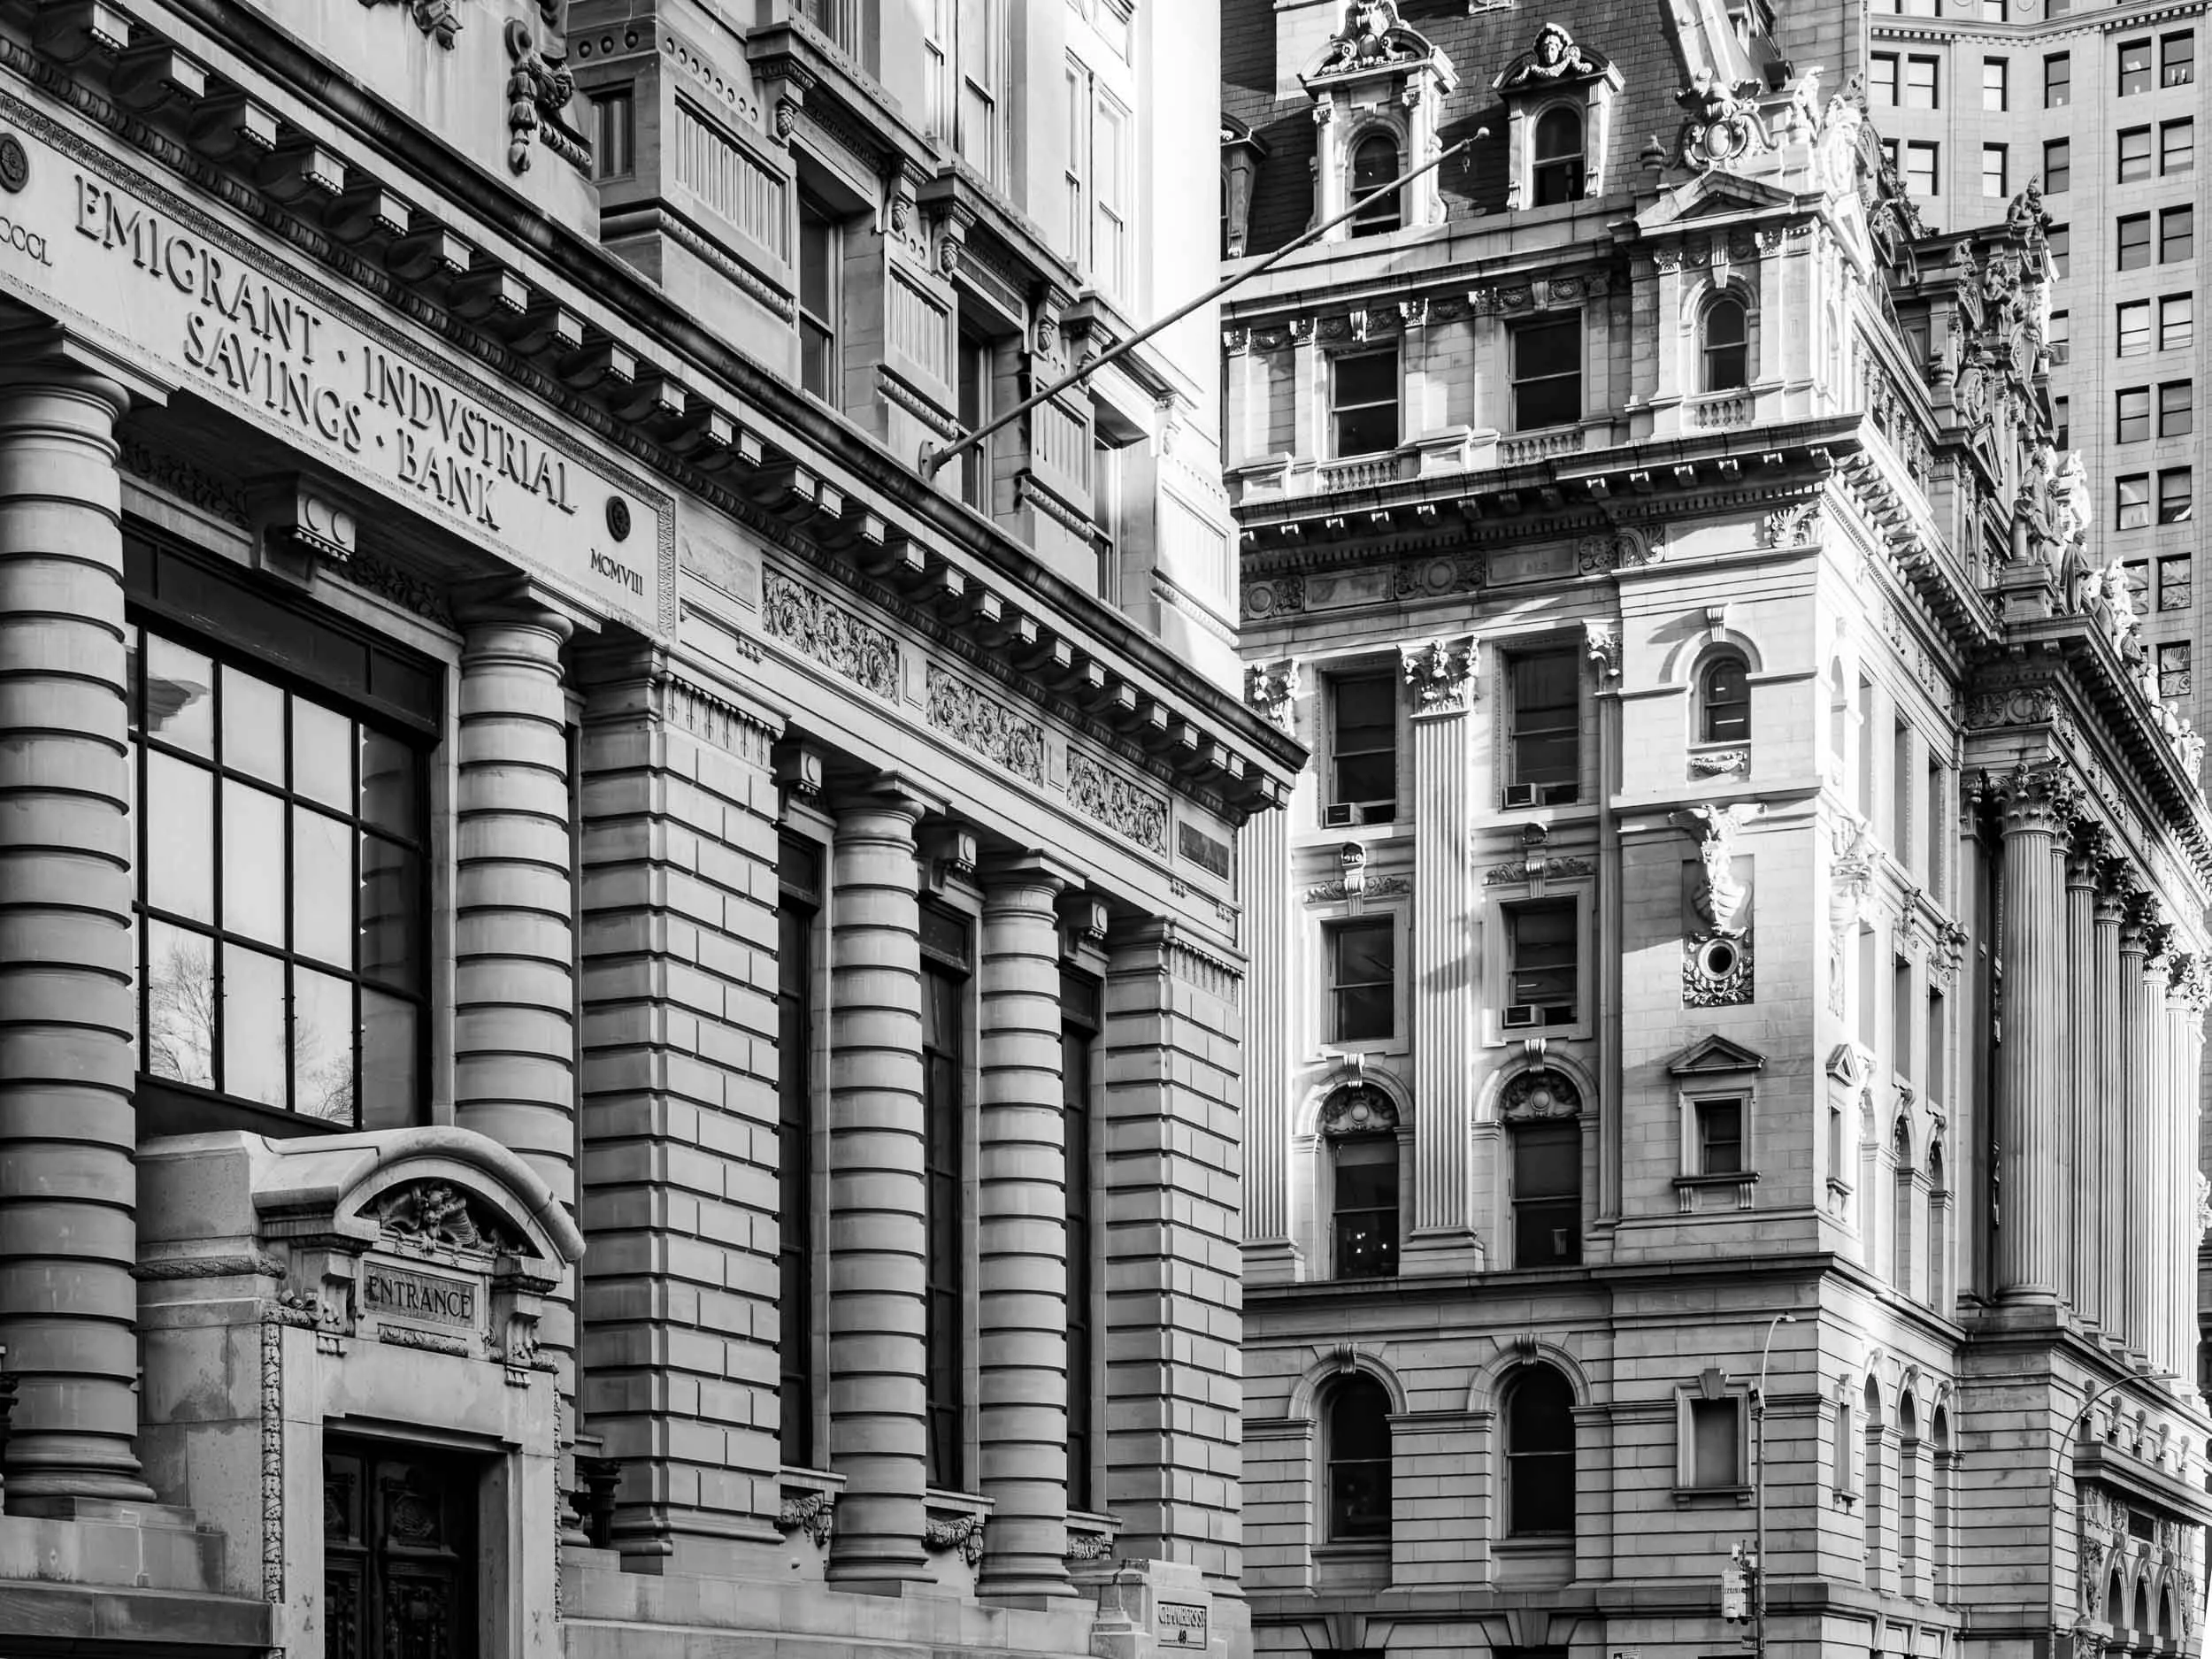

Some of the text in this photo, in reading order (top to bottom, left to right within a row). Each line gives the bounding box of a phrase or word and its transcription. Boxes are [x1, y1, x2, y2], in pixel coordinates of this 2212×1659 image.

[74, 174, 579, 516] EMIGRANT INDVSTRIAL
[183, 311, 501, 532] SAVINGS BANK
[590, 548, 643, 596] MCMVIII
[367, 1274, 472, 1320] ENTRANCE
